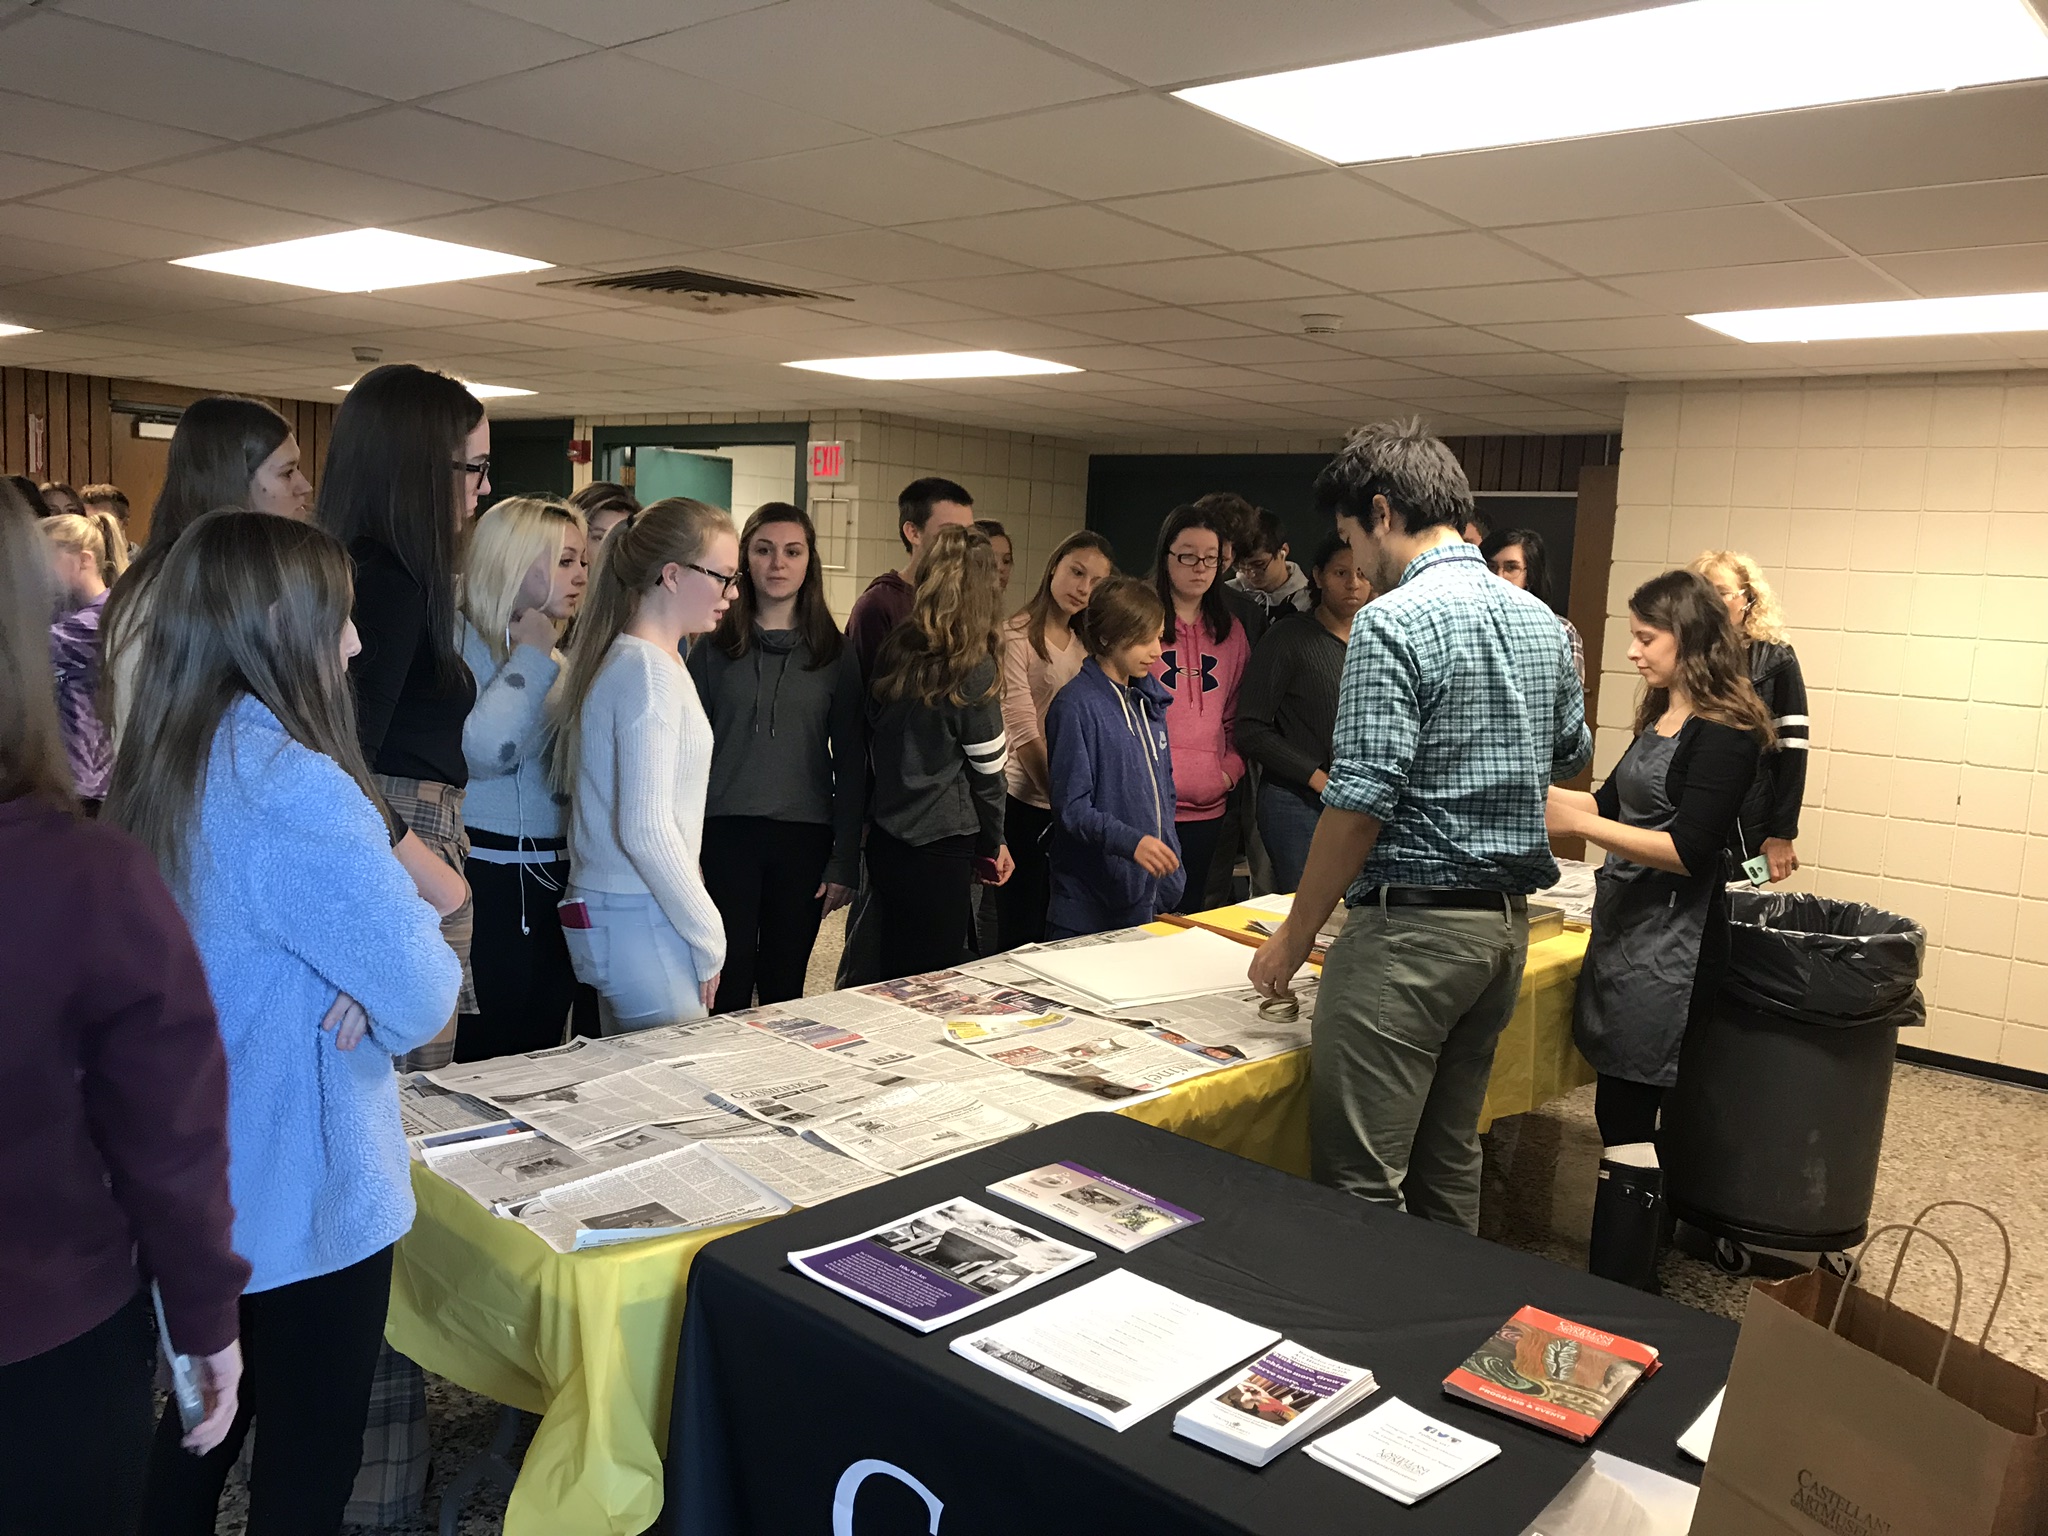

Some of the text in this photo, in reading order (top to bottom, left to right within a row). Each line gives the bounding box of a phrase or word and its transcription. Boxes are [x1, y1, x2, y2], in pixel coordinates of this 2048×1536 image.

[813, 446, 841, 476] EXIT
[731, 1081, 809, 1099] CLASSIFIEDS
[1478, 1386, 1526, 1407] PROGRAMS
[1534, 1405, 1567, 1421] EVENTS
[1797, 1468, 1892, 1535] CASTELLANI
